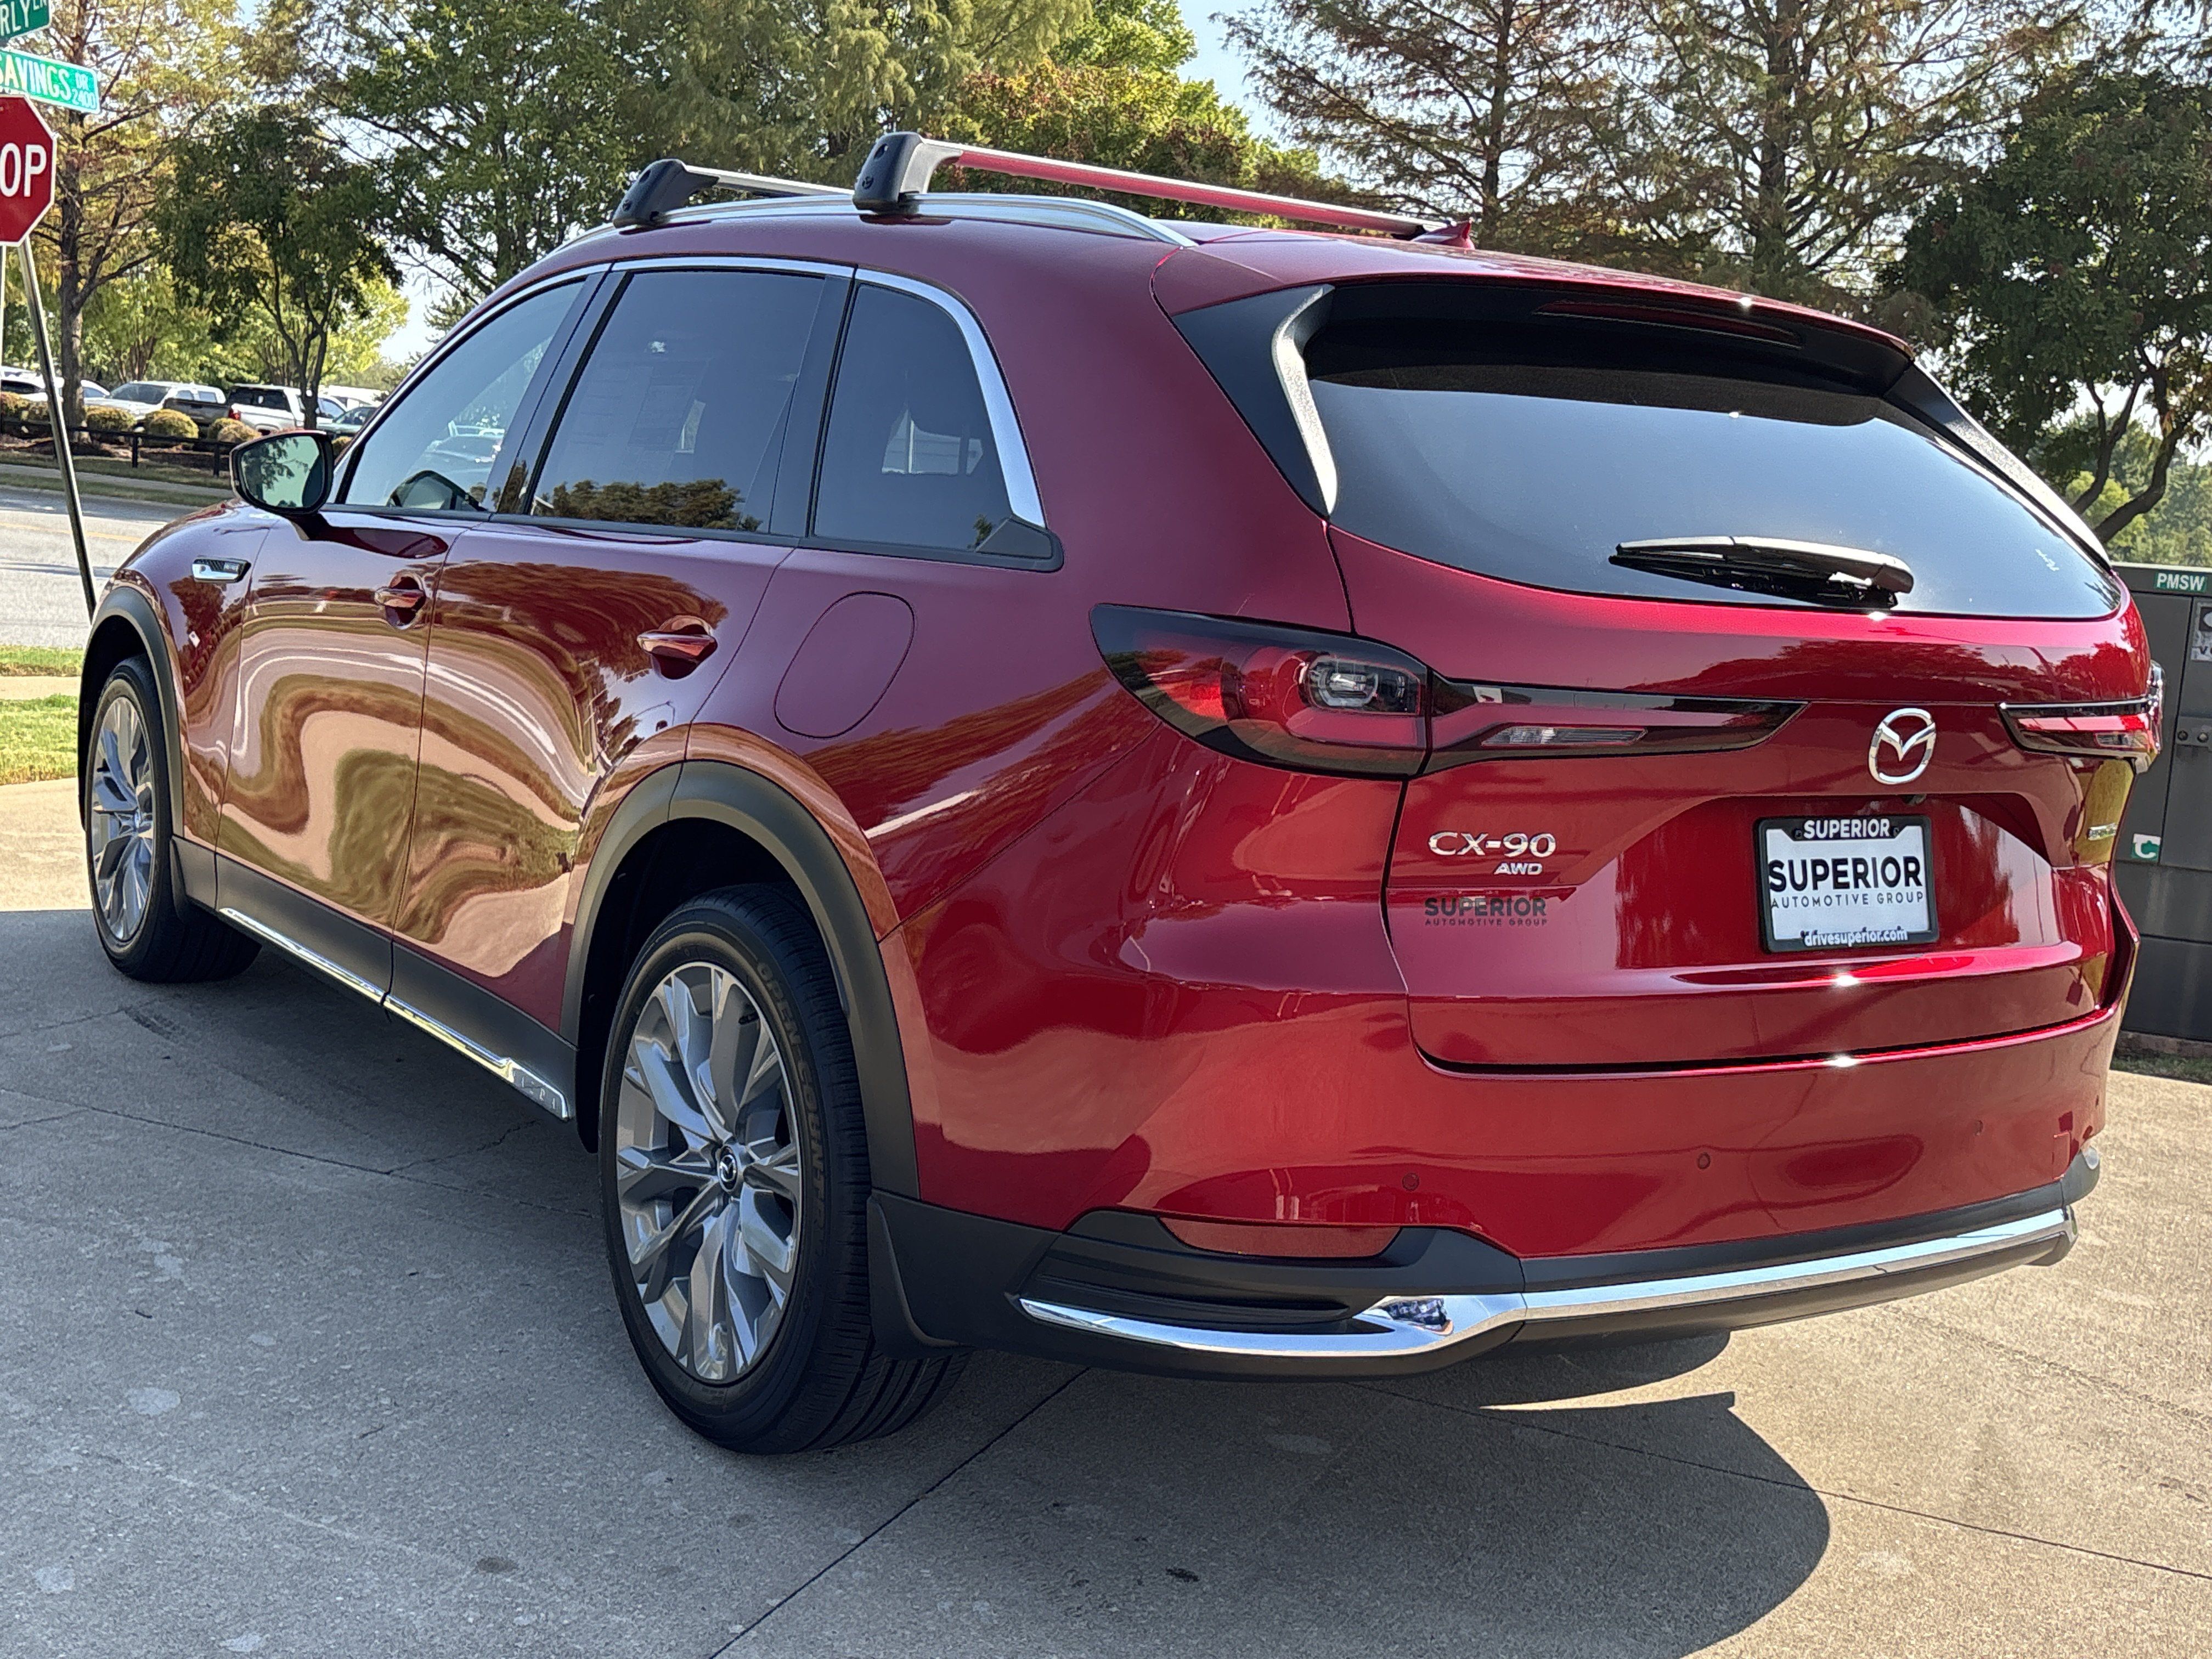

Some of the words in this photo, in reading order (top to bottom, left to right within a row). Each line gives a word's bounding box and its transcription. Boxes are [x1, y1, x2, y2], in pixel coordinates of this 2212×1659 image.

[0, 54, 71, 101] AVINGS
[75, 72, 89, 91] DR
[71, 88, 96, 109] 2400
[2156, 573, 2205, 591] PMSW
[1803, 818, 1891, 839] SUPERIOR
[1428, 831, 1556, 858] CX-90
[1493, 862, 1543, 875] AWD
[1768, 856, 1923, 892] SUPERIOR
[1425, 897, 1547, 916] SUPERIOR
[1771, 893, 1869, 909] AUTOMOTIVE
[1877, 891, 1923, 905] GROUP
[1425, 917, 1502, 927] AUTOMOTIVE
[1509, 917, 1548, 927] GROUP
[1803, 928, 1909, 947] drivesuperior.com
